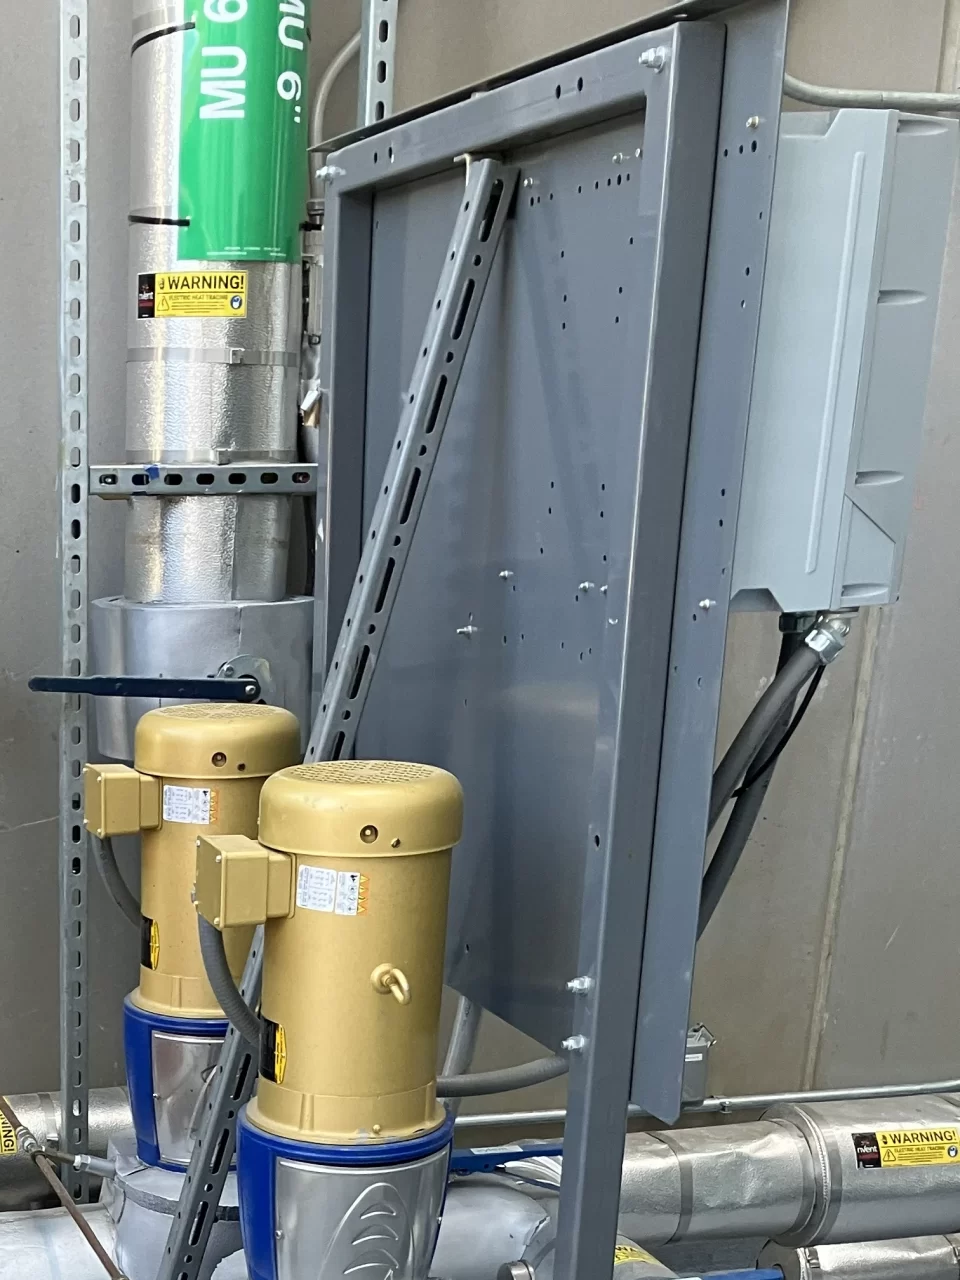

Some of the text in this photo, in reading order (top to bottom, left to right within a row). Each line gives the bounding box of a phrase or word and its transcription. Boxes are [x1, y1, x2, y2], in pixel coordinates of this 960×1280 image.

[198, 45, 248, 120] MU
[167, 275, 244, 290] WARNING!
[889, 1130, 957, 1145] WARNING!
